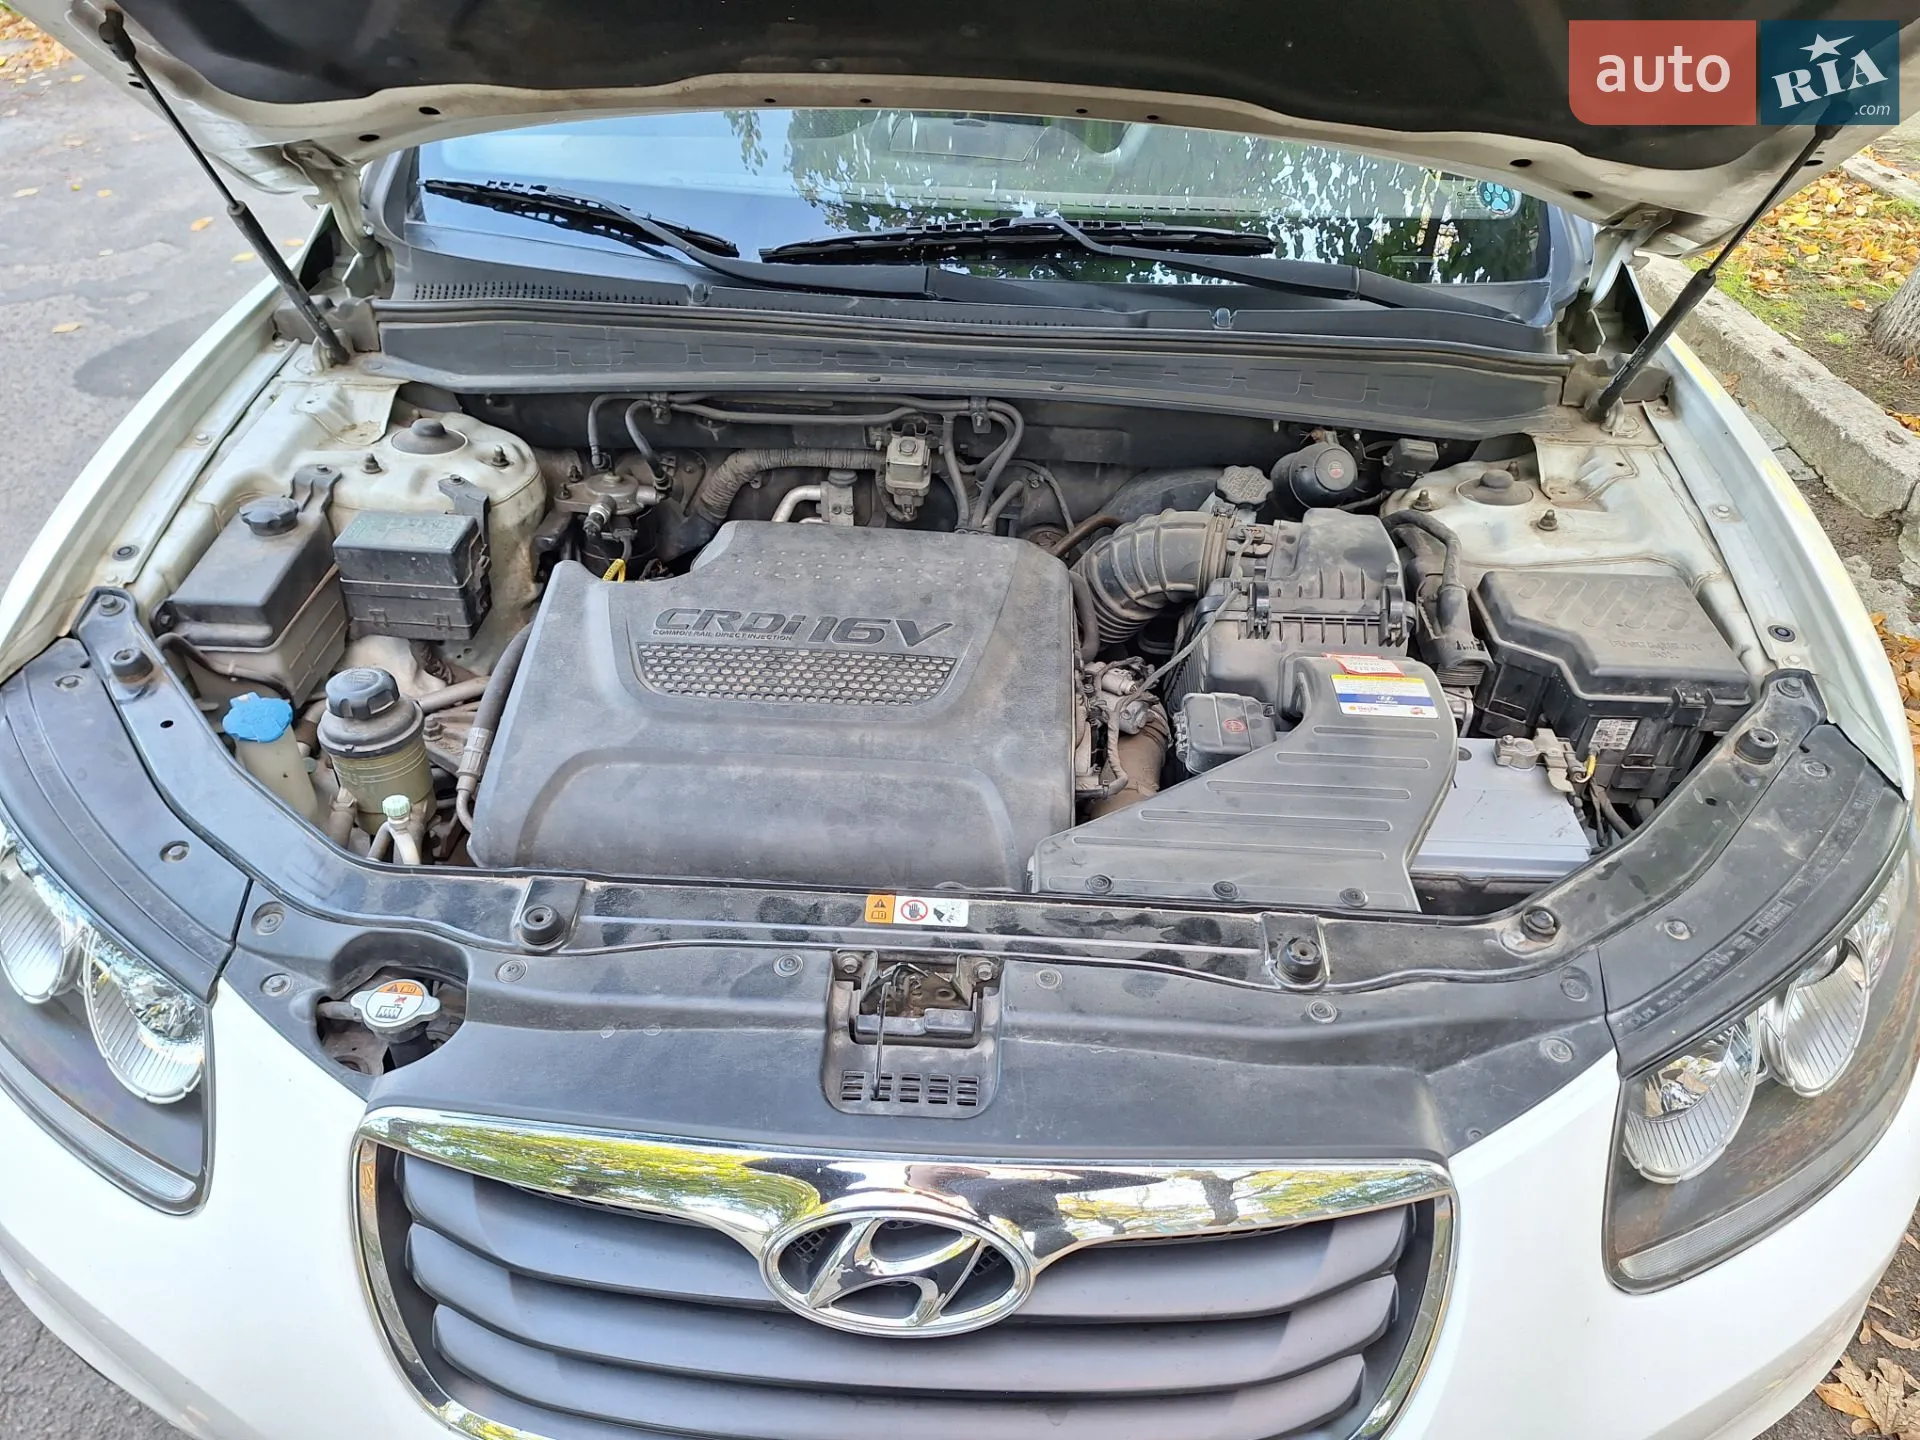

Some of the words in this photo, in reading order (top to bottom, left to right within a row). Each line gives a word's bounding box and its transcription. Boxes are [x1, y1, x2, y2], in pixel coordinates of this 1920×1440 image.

[652, 629, 691, 637] COMMON
[693, 630, 713, 638] RAIL
[747, 633, 793, 642] INJECTION
[654, 607, 807, 636] CRDi
[807, 615, 954, 648] 16V
